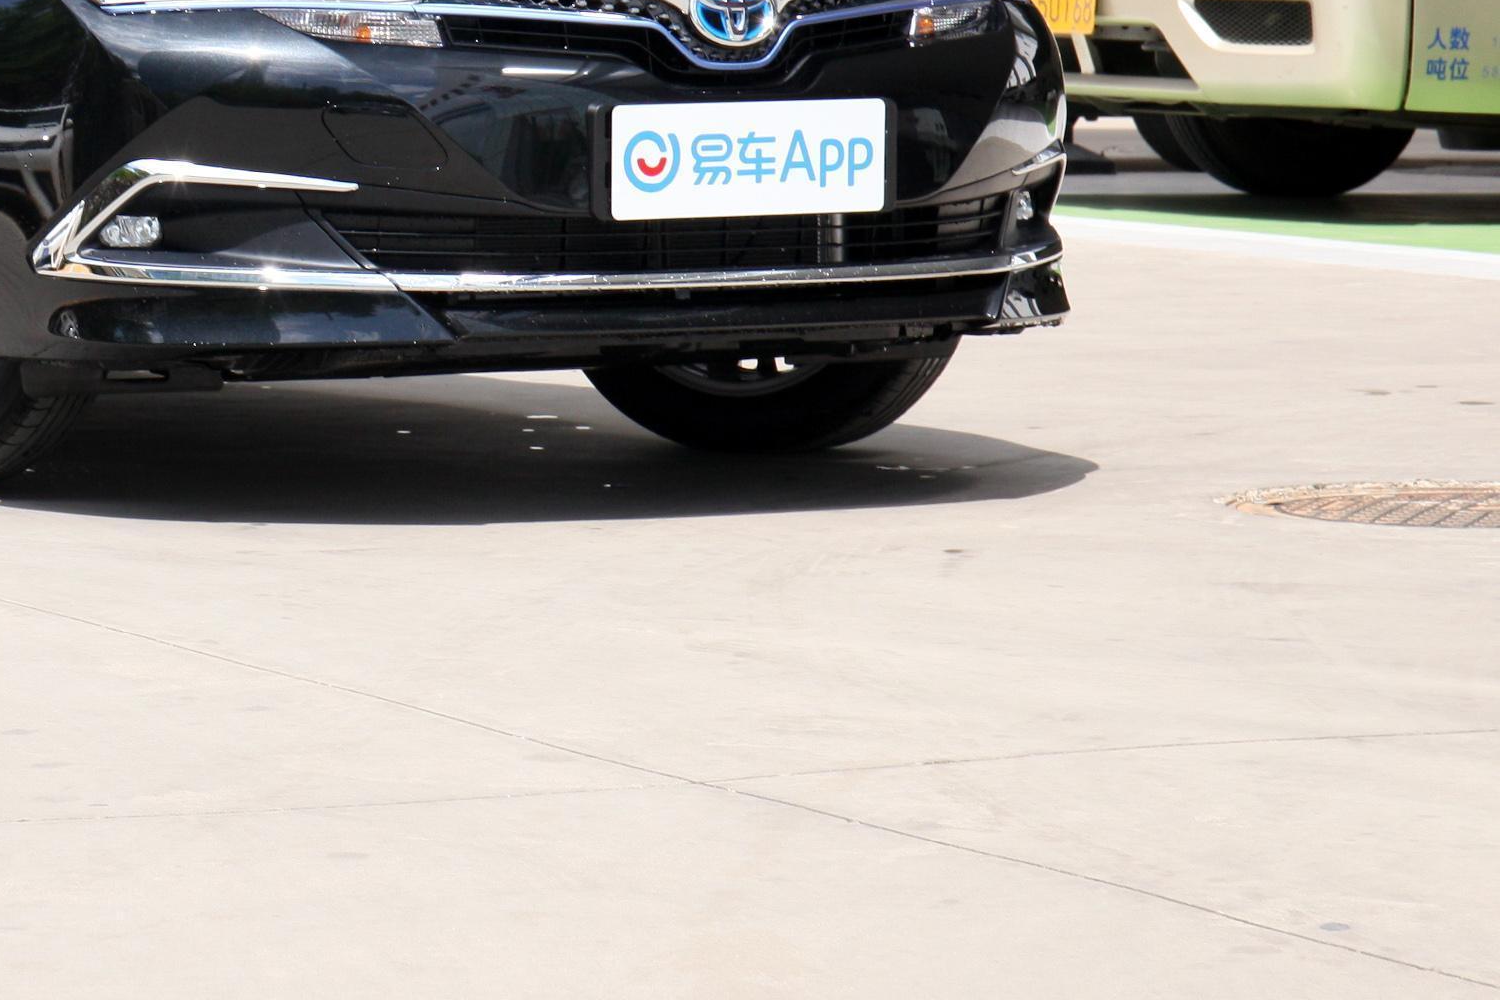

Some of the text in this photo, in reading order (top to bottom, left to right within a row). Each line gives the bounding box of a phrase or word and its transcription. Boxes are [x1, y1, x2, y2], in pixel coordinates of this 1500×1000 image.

[1427, 26, 1470, 51] 人数
[1426, 57, 1470, 81] 吨位
[690, 129, 874, 188] 易车App
